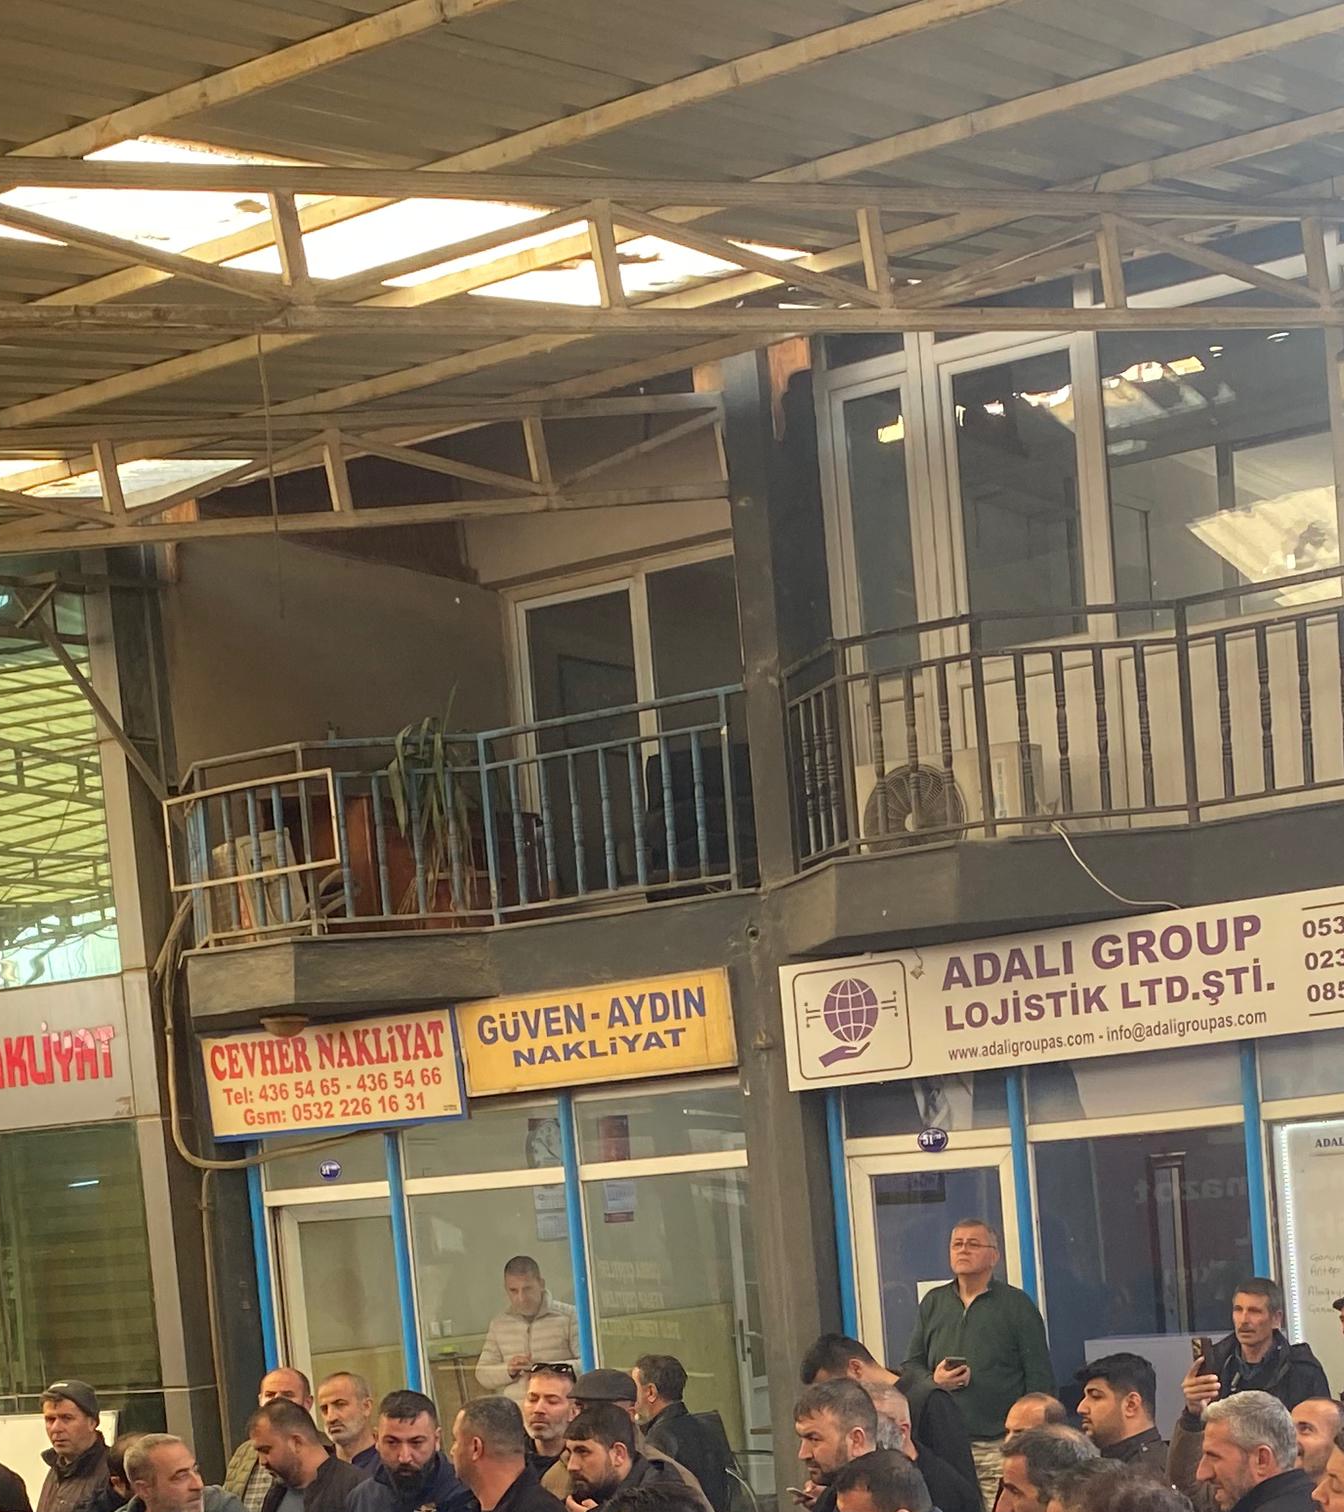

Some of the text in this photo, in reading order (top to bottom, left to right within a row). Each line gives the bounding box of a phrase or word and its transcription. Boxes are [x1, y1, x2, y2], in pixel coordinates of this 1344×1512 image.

[942, 914, 1262, 991] ADALI GROUP
[477, 1003, 586, 1046] GÜVEN
[607, 986, 707, 1029] AYDIN
[945, 982, 1109, 1031] LOJİSTİK
[210, 1036, 312, 1082] CEVHER
[948, 1030, 1095, 1061] www.adaligroupas.com
[1106, 1009, 1267, 1042] info@adaligroupas.com
[223, 1087, 254, 1106] Tel:
[259, 1083, 289, 1102] 436
[295, 1080, 316, 1099] 54
[320, 1077, 340, 1096] 65
[357, 1073, 387, 1093] 436
[393, 1069, 415, 1088] 54
[421, 1067, 442, 1086] 66
[244, 1091, 426, 1127] Gsm: 0532 226 16 31
